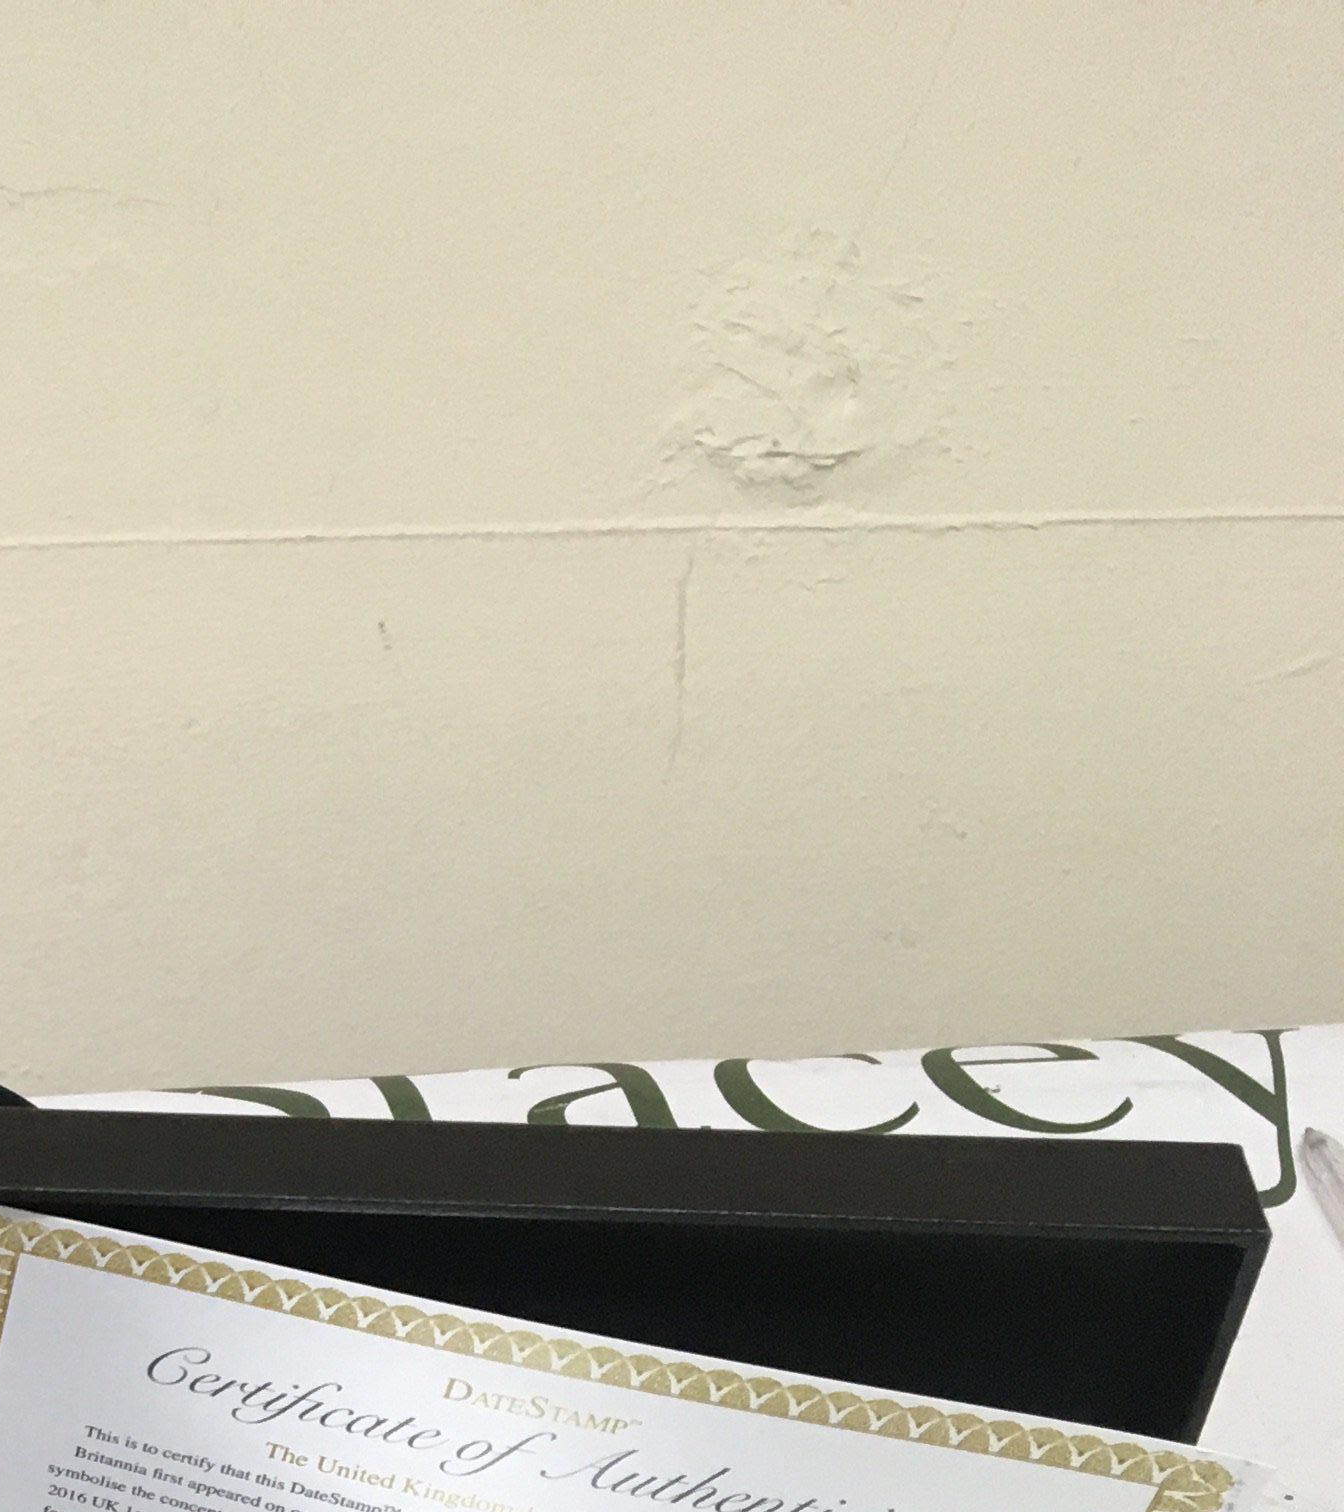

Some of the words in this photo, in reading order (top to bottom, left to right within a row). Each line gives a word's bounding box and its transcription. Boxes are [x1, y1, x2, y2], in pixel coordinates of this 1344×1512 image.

[145, 1345, 454, 1451] Certificate
[439, 1429, 554, 1478] of
[47, 1483, 88, 1505] 2016
